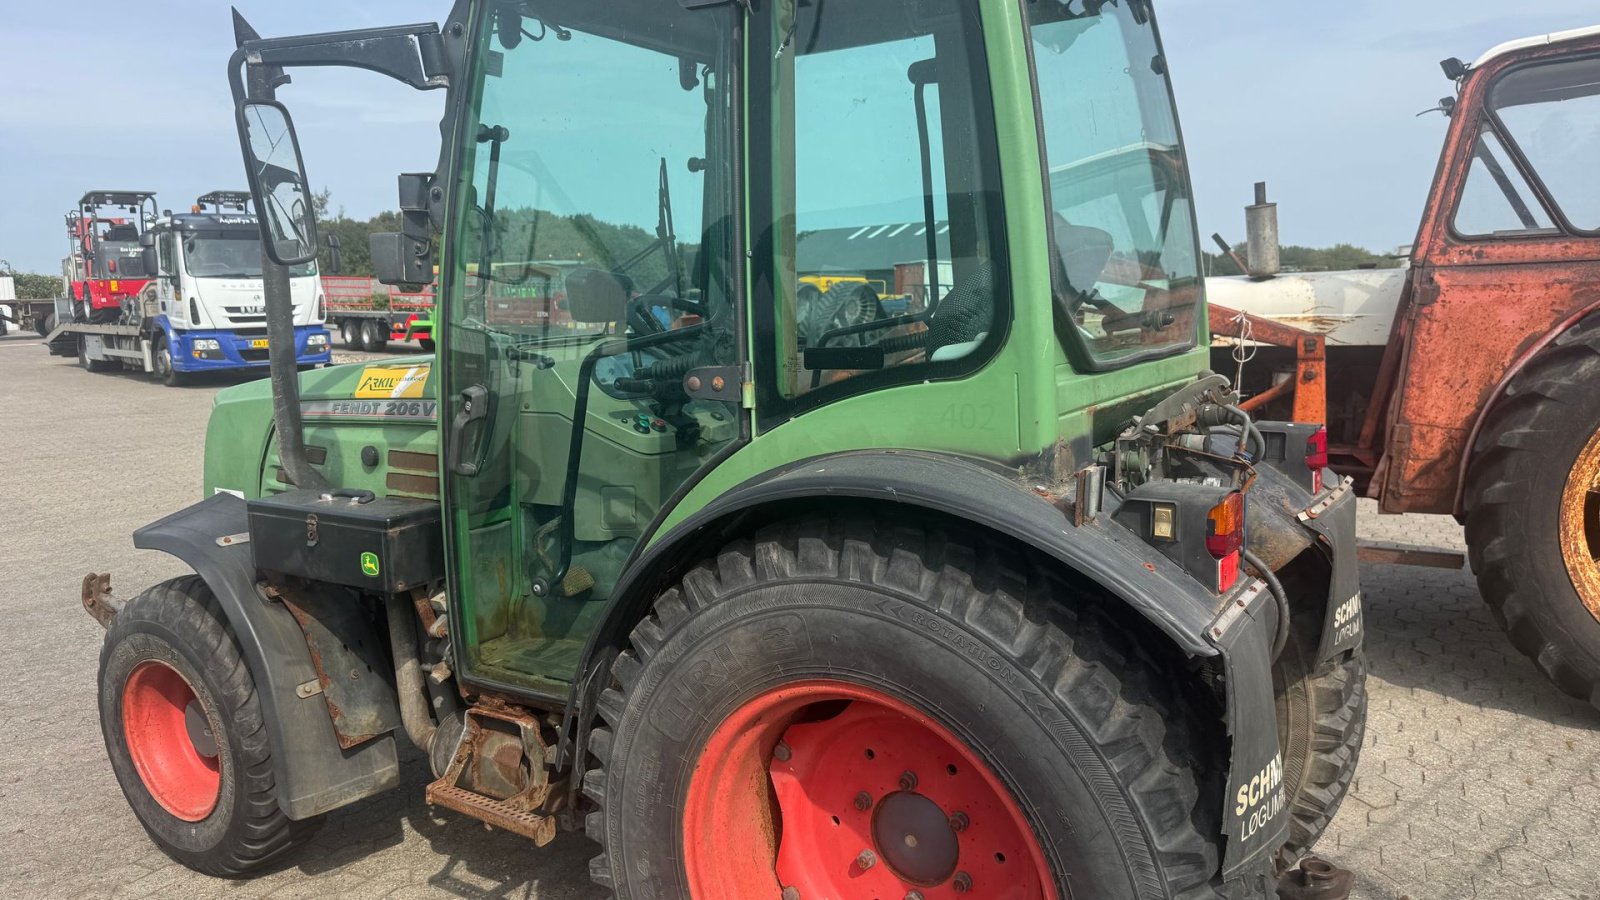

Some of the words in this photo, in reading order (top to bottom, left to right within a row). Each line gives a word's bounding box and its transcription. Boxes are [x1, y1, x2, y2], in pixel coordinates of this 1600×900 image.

[240, 306, 265, 314] IVE
[359, 377, 394, 391] ARKIL
[332, 402, 380, 415] FENDT
[941, 403, 996, 430] 402
[911, 611, 1017, 684] ROTATION
